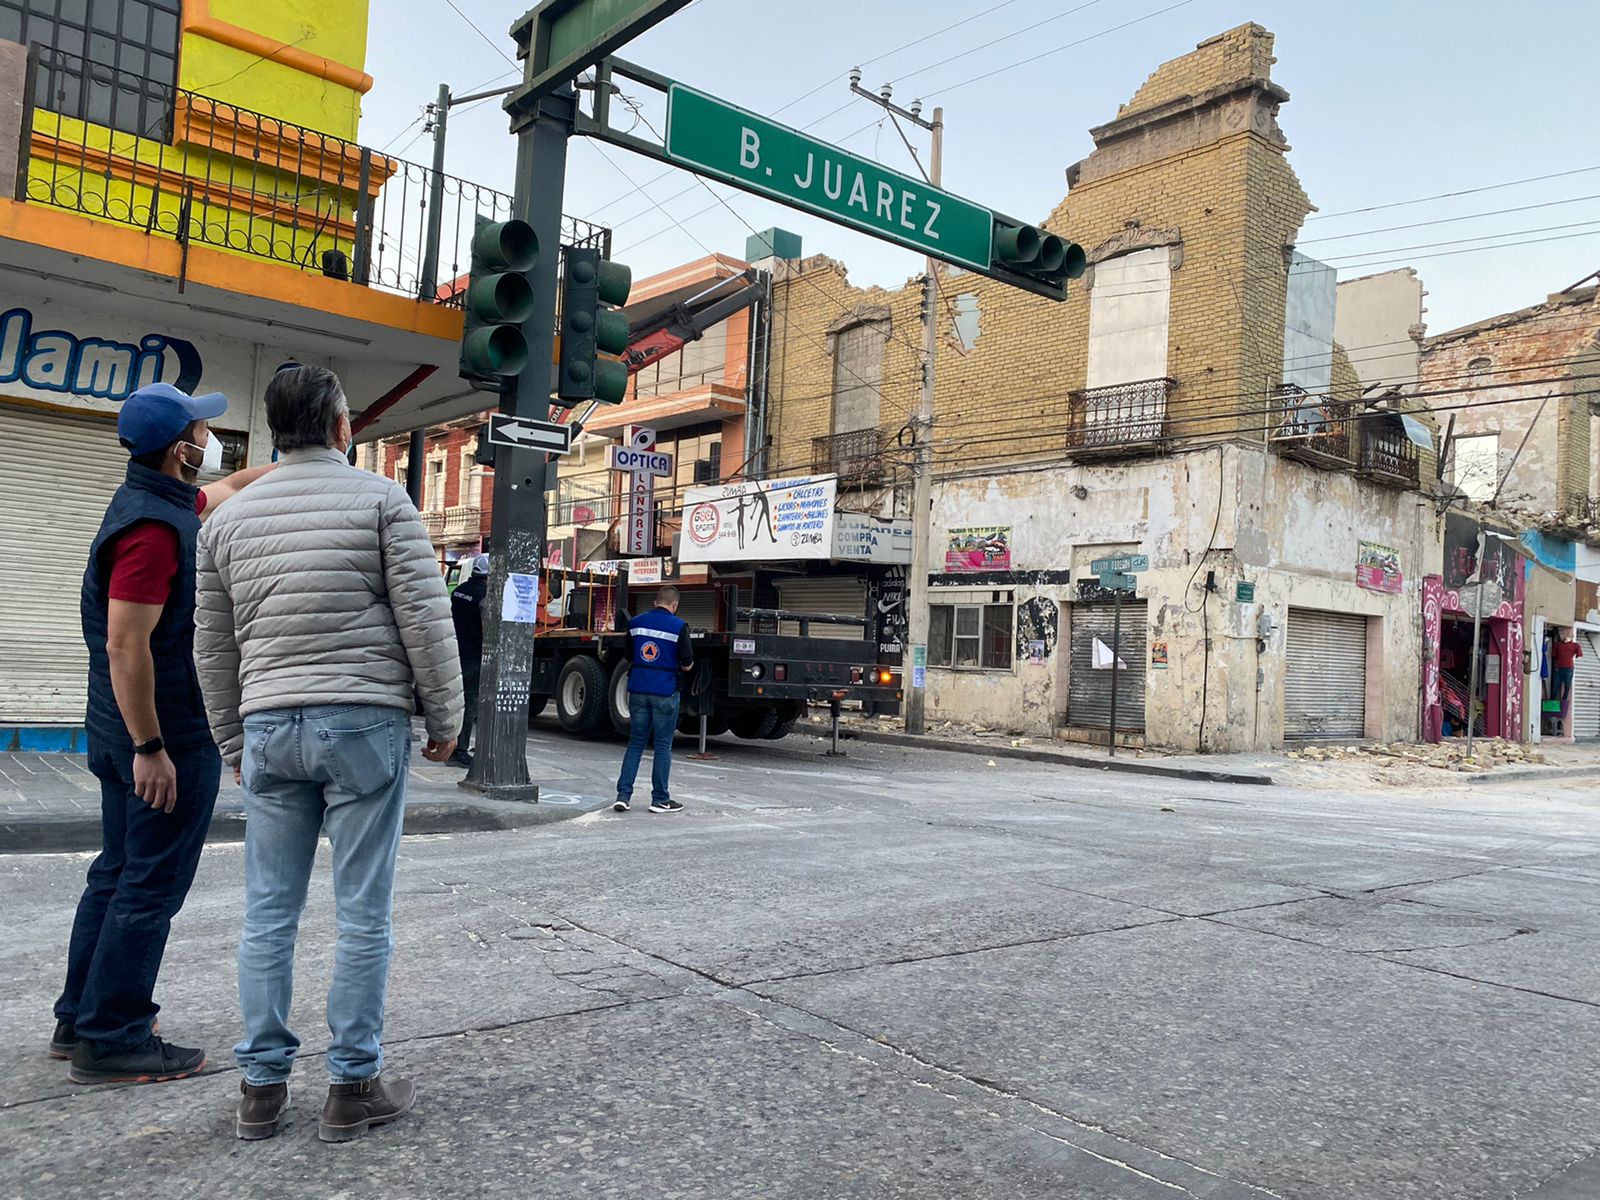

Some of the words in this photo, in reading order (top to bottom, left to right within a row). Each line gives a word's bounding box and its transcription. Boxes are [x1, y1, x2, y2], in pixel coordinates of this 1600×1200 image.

[740, 127, 772, 177] B.
[793, 153, 942, 240] JUAREZ
[617, 451, 668, 471] OPTICA
[722, 485, 747, 498] ZUMBA
[793, 487, 824, 499] CALCETAS
[636, 473, 646, 551] LONDRES
[801, 532, 823, 544] ZUMBA
[837, 532, 878, 546] COMPRA
[838, 545, 872, 555] VENTA
[880, 643, 901, 653] PUMA
